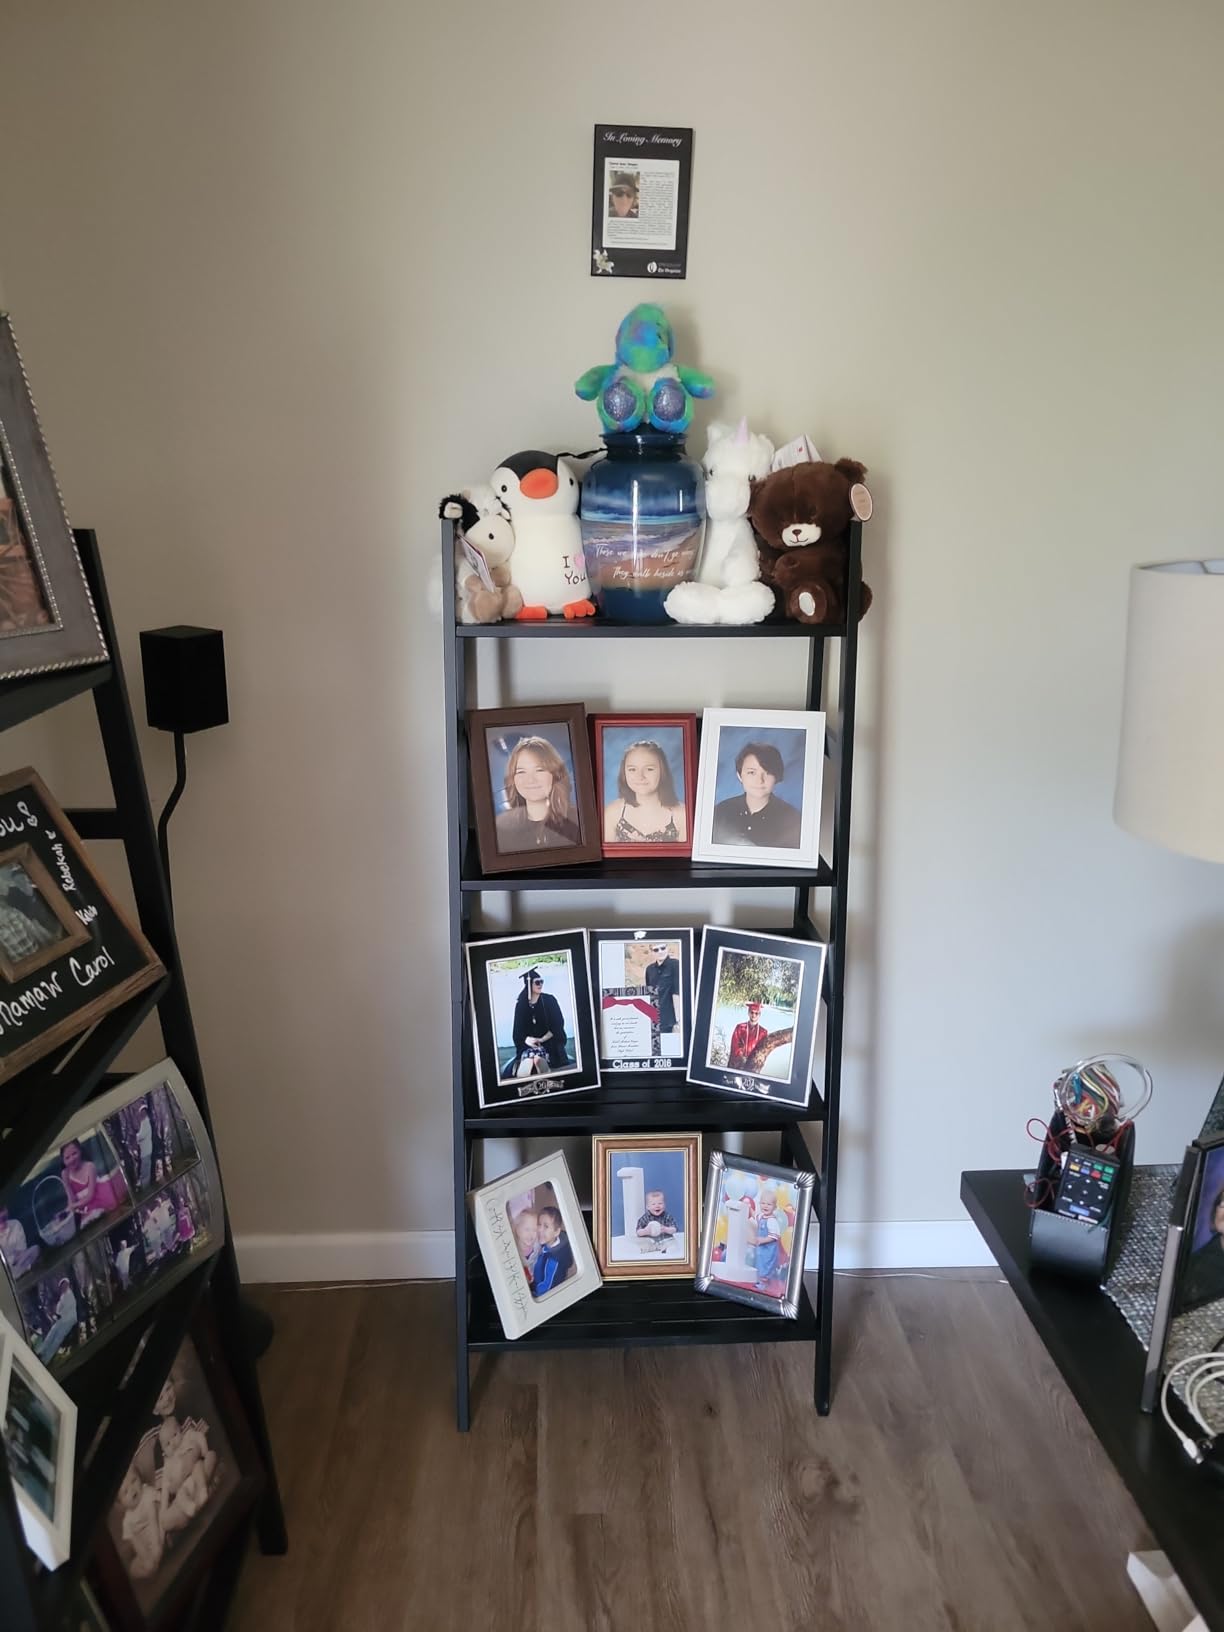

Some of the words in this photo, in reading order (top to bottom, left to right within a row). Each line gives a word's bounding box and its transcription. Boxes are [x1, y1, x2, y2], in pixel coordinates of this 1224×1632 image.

[602, 131, 616, 142] In
[616, 131, 646, 147] Loving
[646, 133, 682, 148] Memory
[562, 555, 571, 569] I
[564, 570, 586, 585] You
[51, 843, 77, 891] Rebekah
[69, 945, 115, 987] Carol
[612, 1059, 640, 1069] Class
[641, 1059, 650, 1068] of
